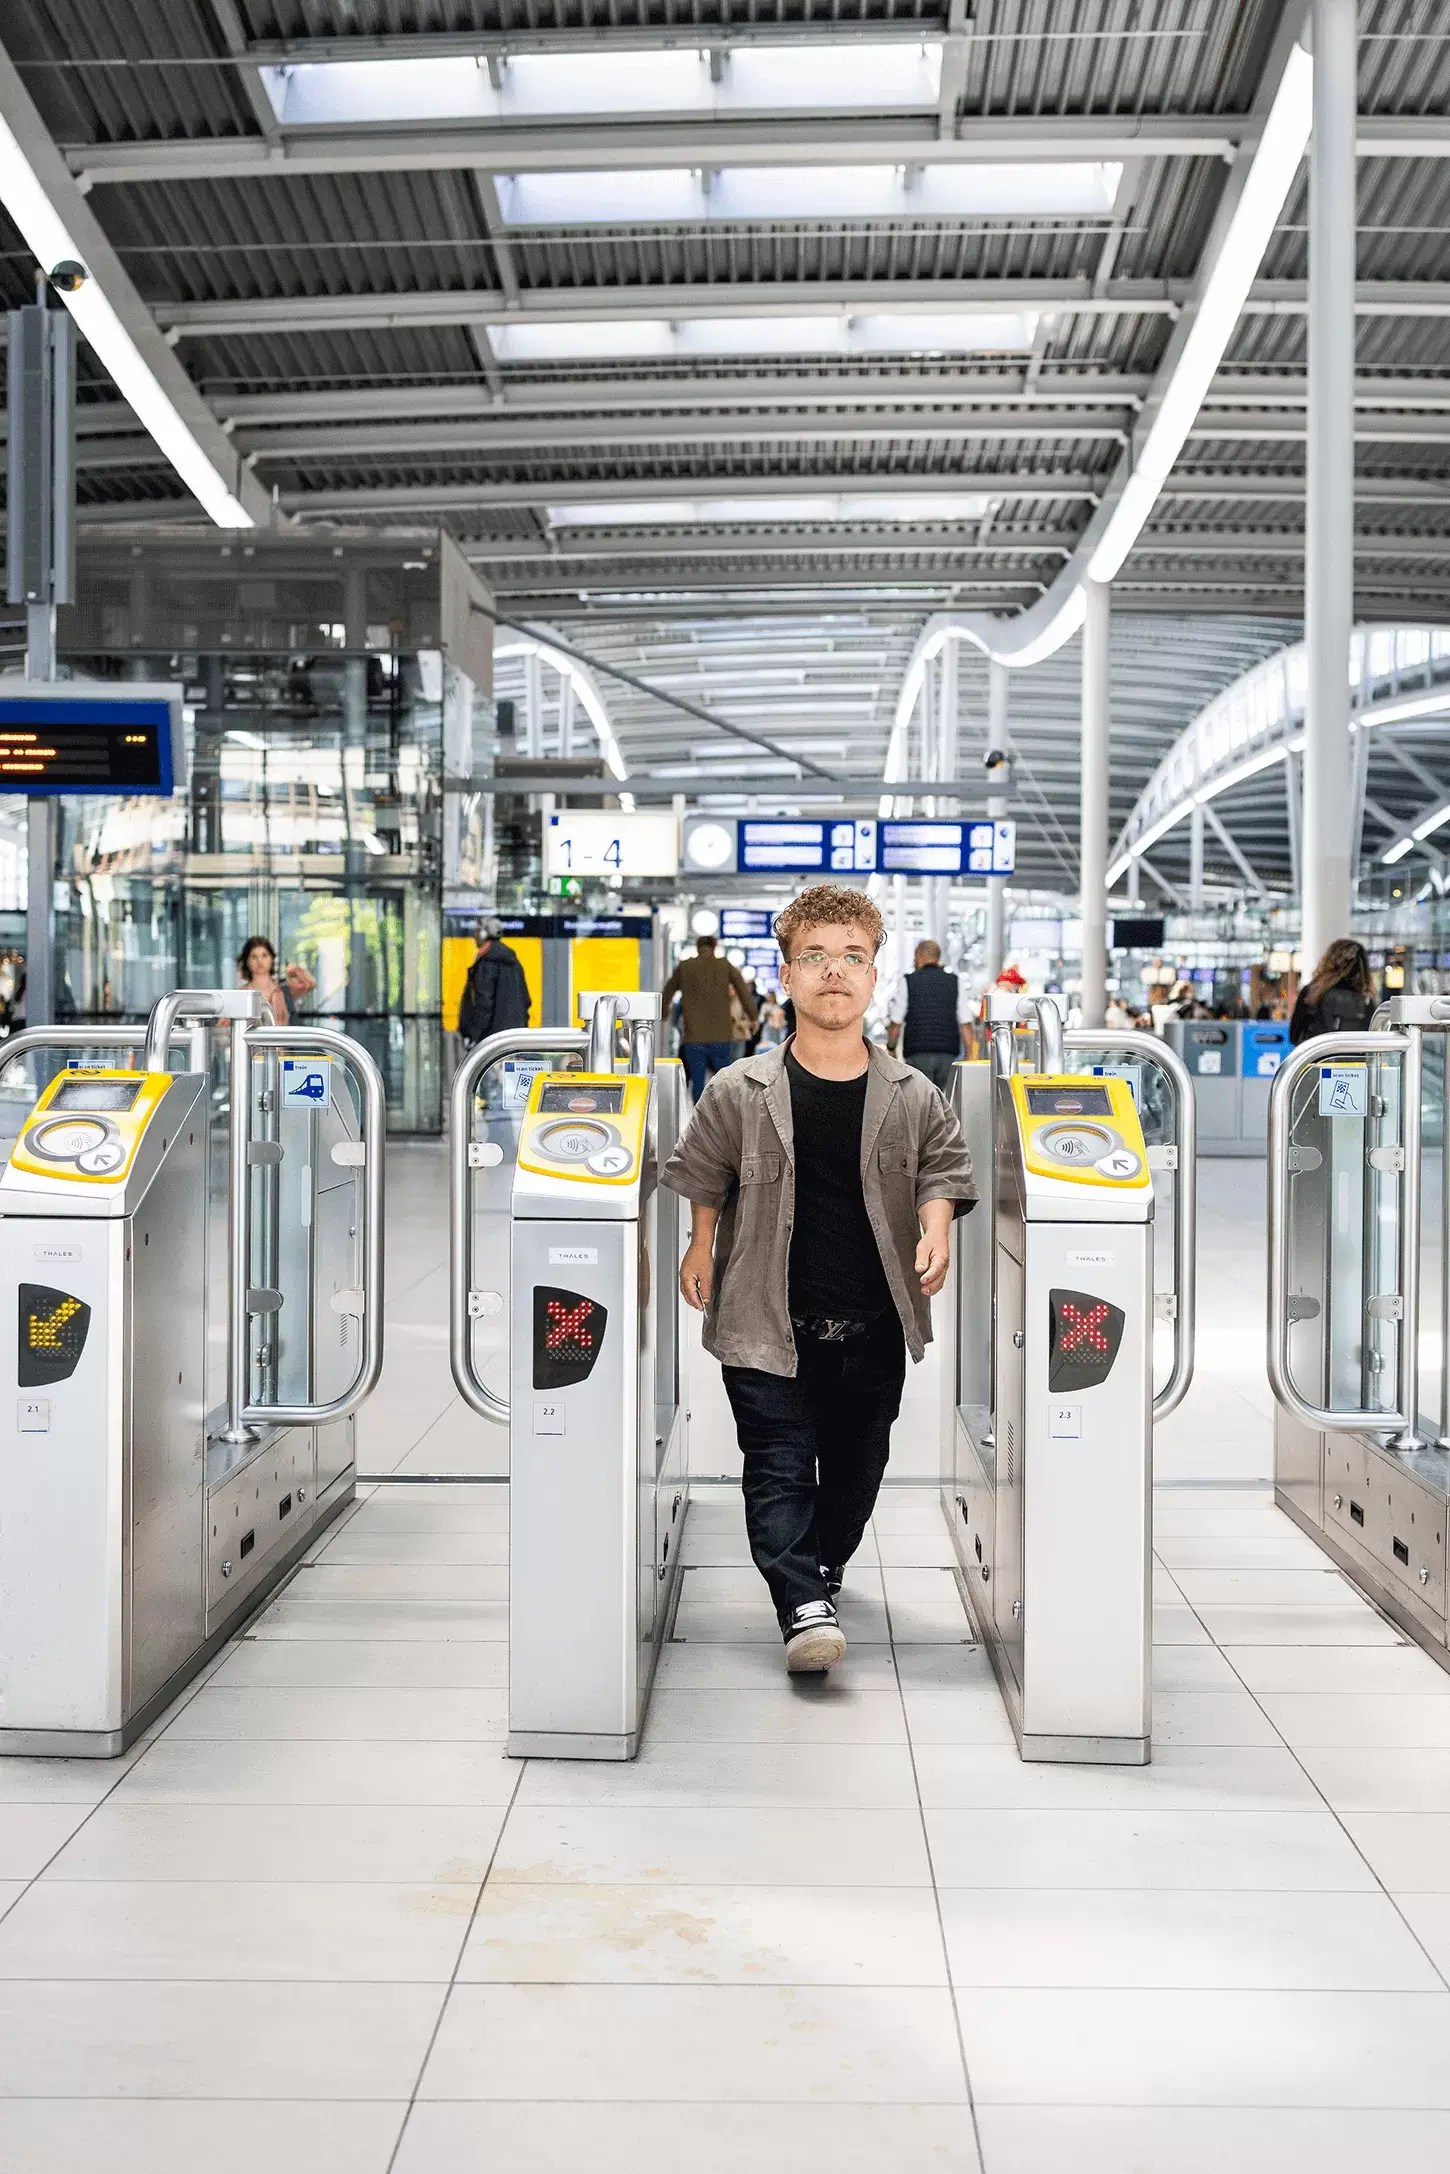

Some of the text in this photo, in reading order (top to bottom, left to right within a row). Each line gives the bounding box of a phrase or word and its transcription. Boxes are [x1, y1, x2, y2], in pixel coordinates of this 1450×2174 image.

[560, 840, 571, 868] 1
[603, 840, 623, 868] 4
[27, 1405, 39, 1413] 2.1
[543, 1408, 555, 1416] 2.2
[1059, 1411, 1072, 1419] 2.3
